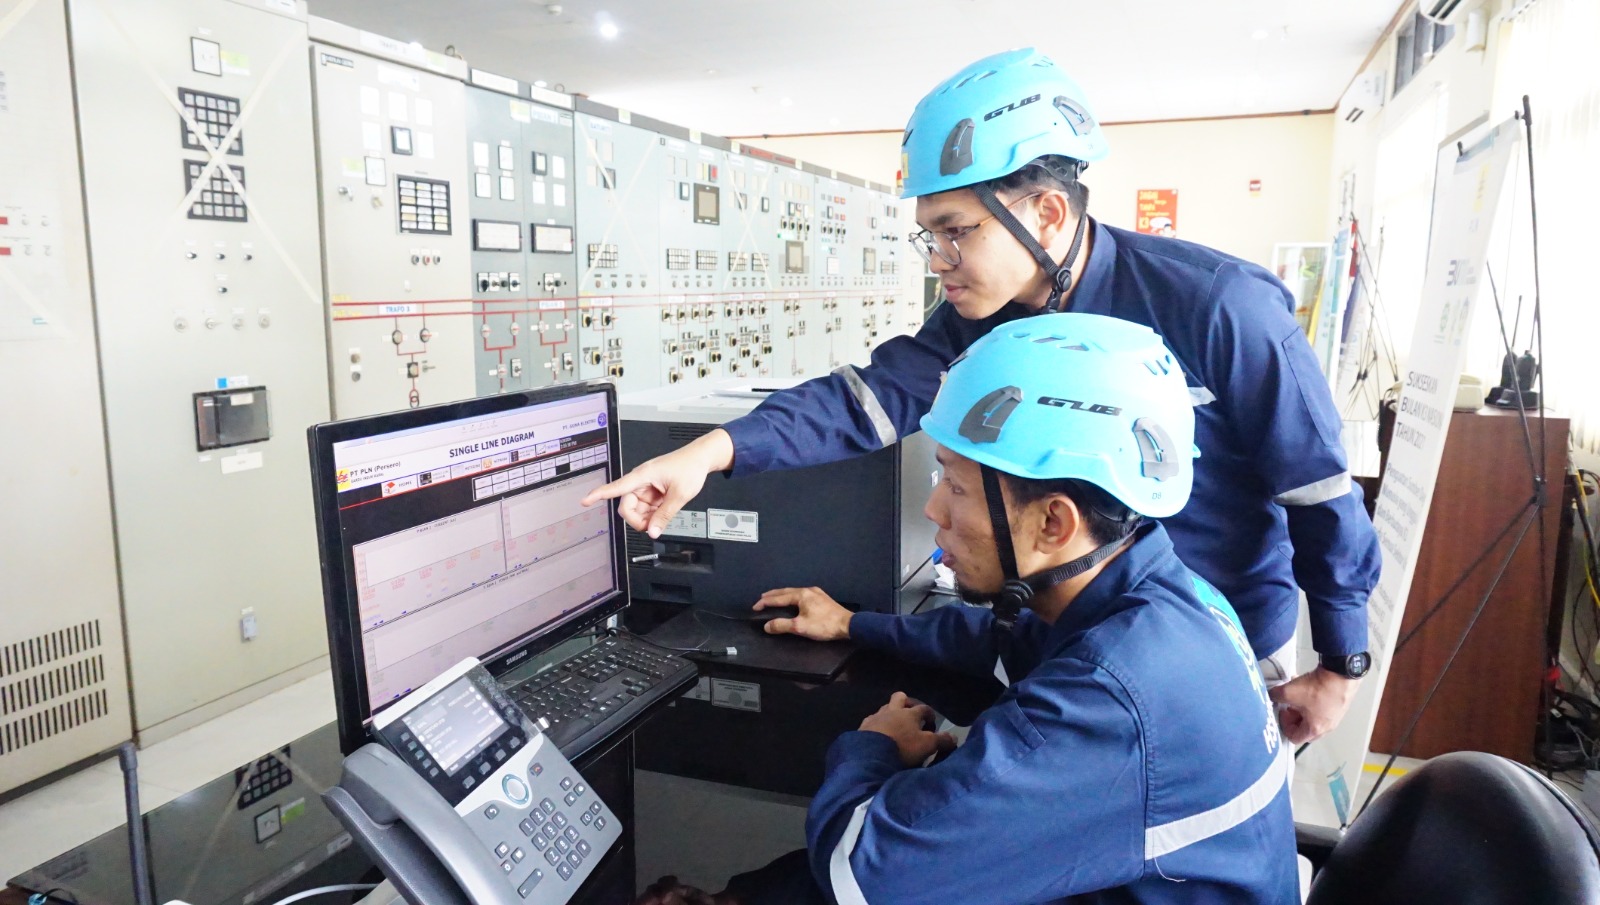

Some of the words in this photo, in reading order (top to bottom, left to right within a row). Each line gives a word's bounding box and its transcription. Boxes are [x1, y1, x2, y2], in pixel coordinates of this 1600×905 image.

[449, 444, 479, 458] SINGLE
[481, 438, 499, 451] LINE
[501, 431, 535, 446] DIAGRAM
[361, 467, 373, 475] PLN
[506, 649, 528, 666] SAMSUNG
